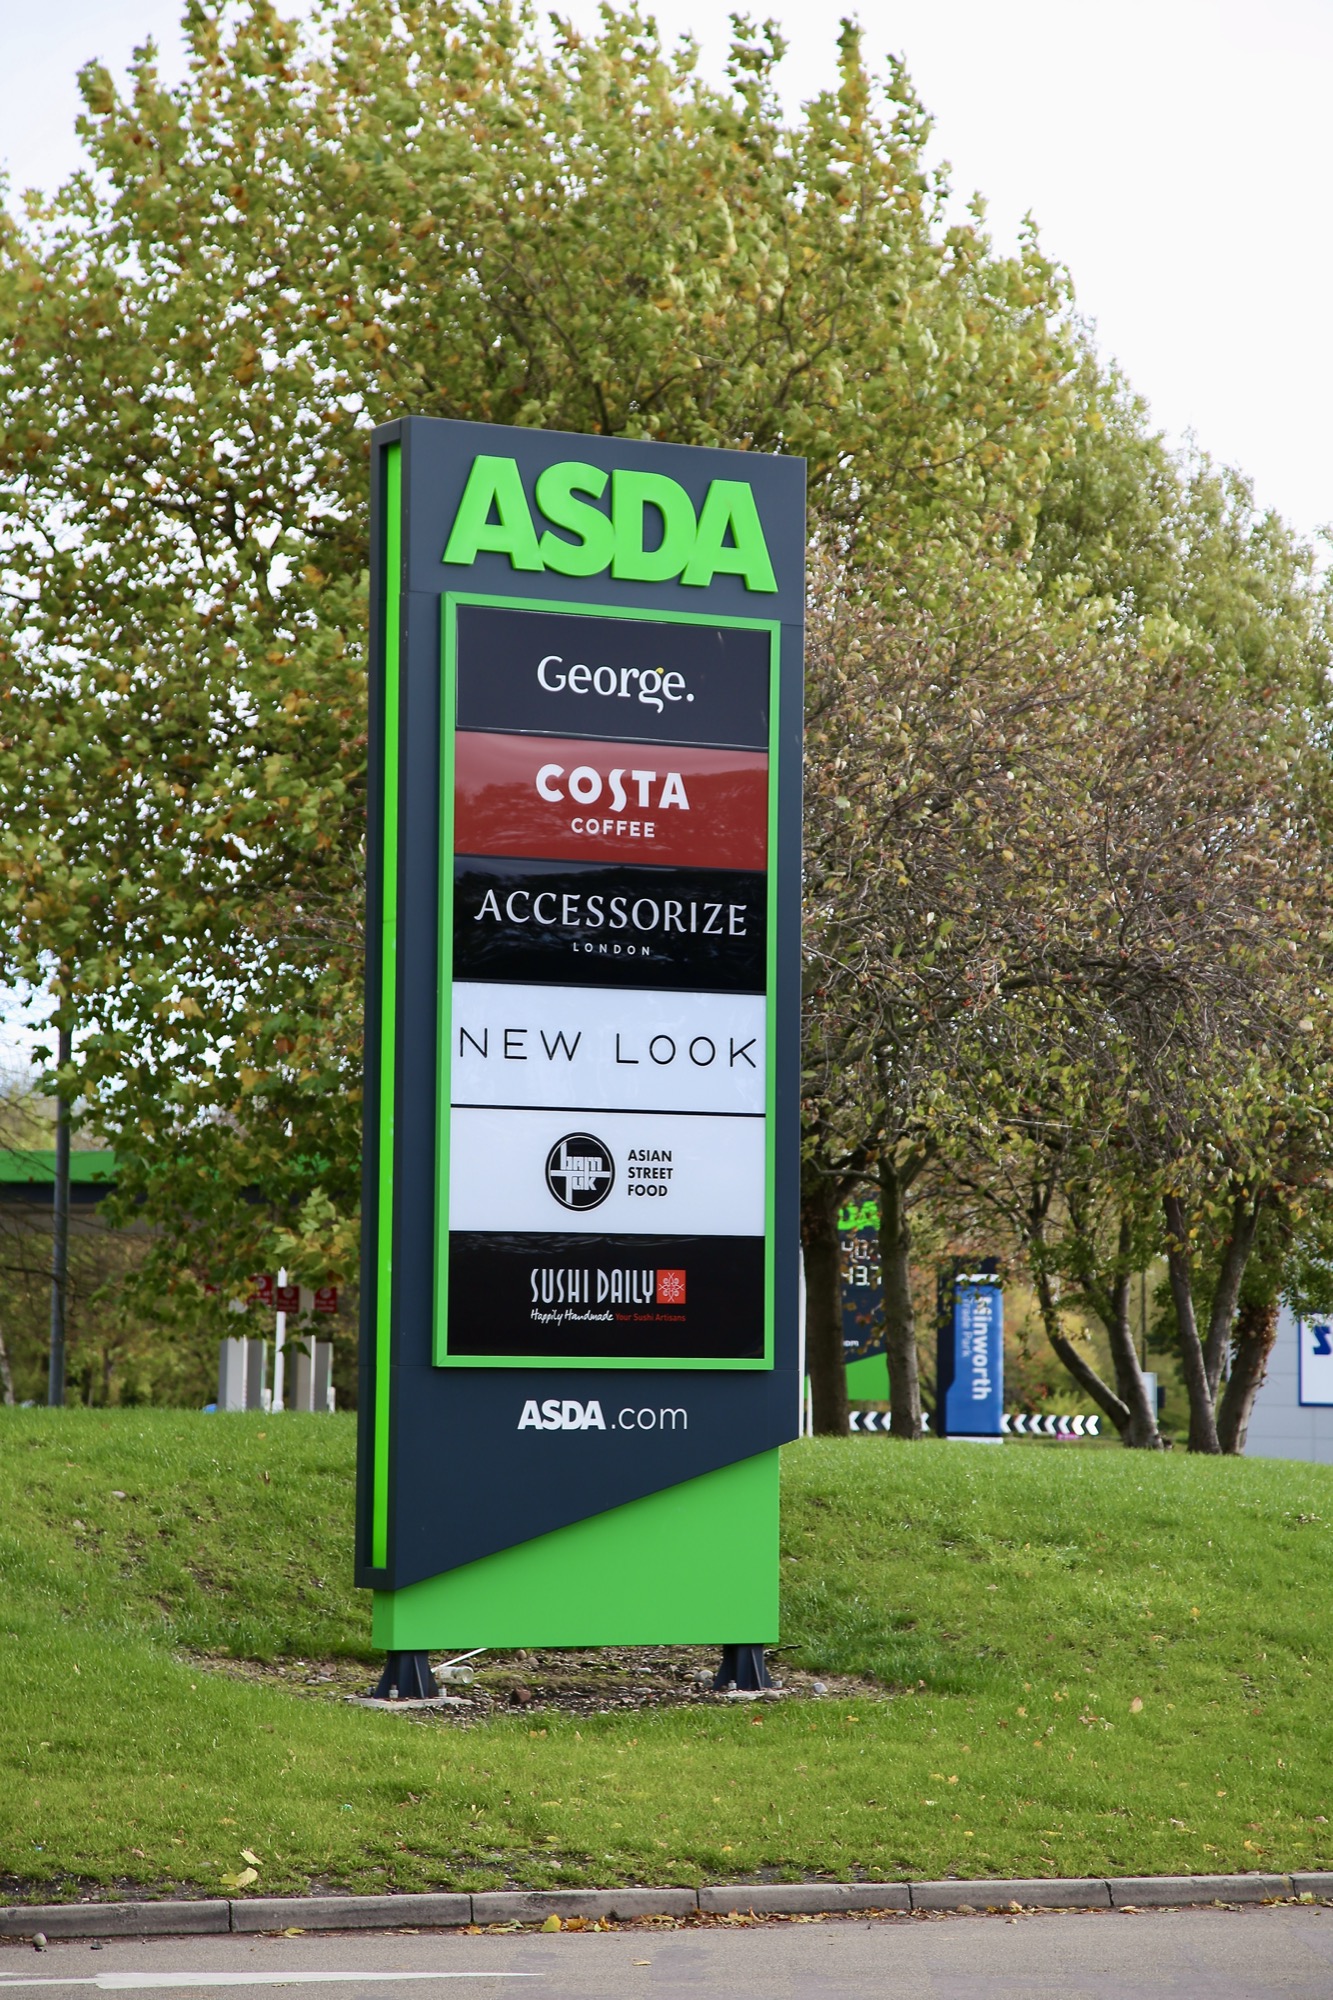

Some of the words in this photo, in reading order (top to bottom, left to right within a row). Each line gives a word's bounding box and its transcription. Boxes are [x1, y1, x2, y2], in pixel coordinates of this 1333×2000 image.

[442, 455, 779, 593] ASDA
[537, 655, 695, 713] George.
[535, 763, 690, 812] COSTA
[571, 817, 655, 838] COFFEE
[474, 889, 747, 936] ACCESSORIZE
[573, 942, 650, 956] LONDON
[460, 1026, 582, 1062] NEW
[616, 1033, 757, 1068] LOOK
[627, 1149, 672, 1162] ASIAN
[627, 1166, 674, 1180] STREET
[627, 1184, 668, 1197] FOOD
[530, 1268, 589, 1303] SUSHI
[596, 1268, 654, 1303] DAILY
[530, 1308, 564, 1326] Happily
[564, 1308, 614, 1321] Handmade
[615, 1313, 632, 1321] Your
[633, 1313, 654, 1321] Sushi
[655, 1313, 687, 1321] Artisans
[962, 1330, 973, 1358] Park
